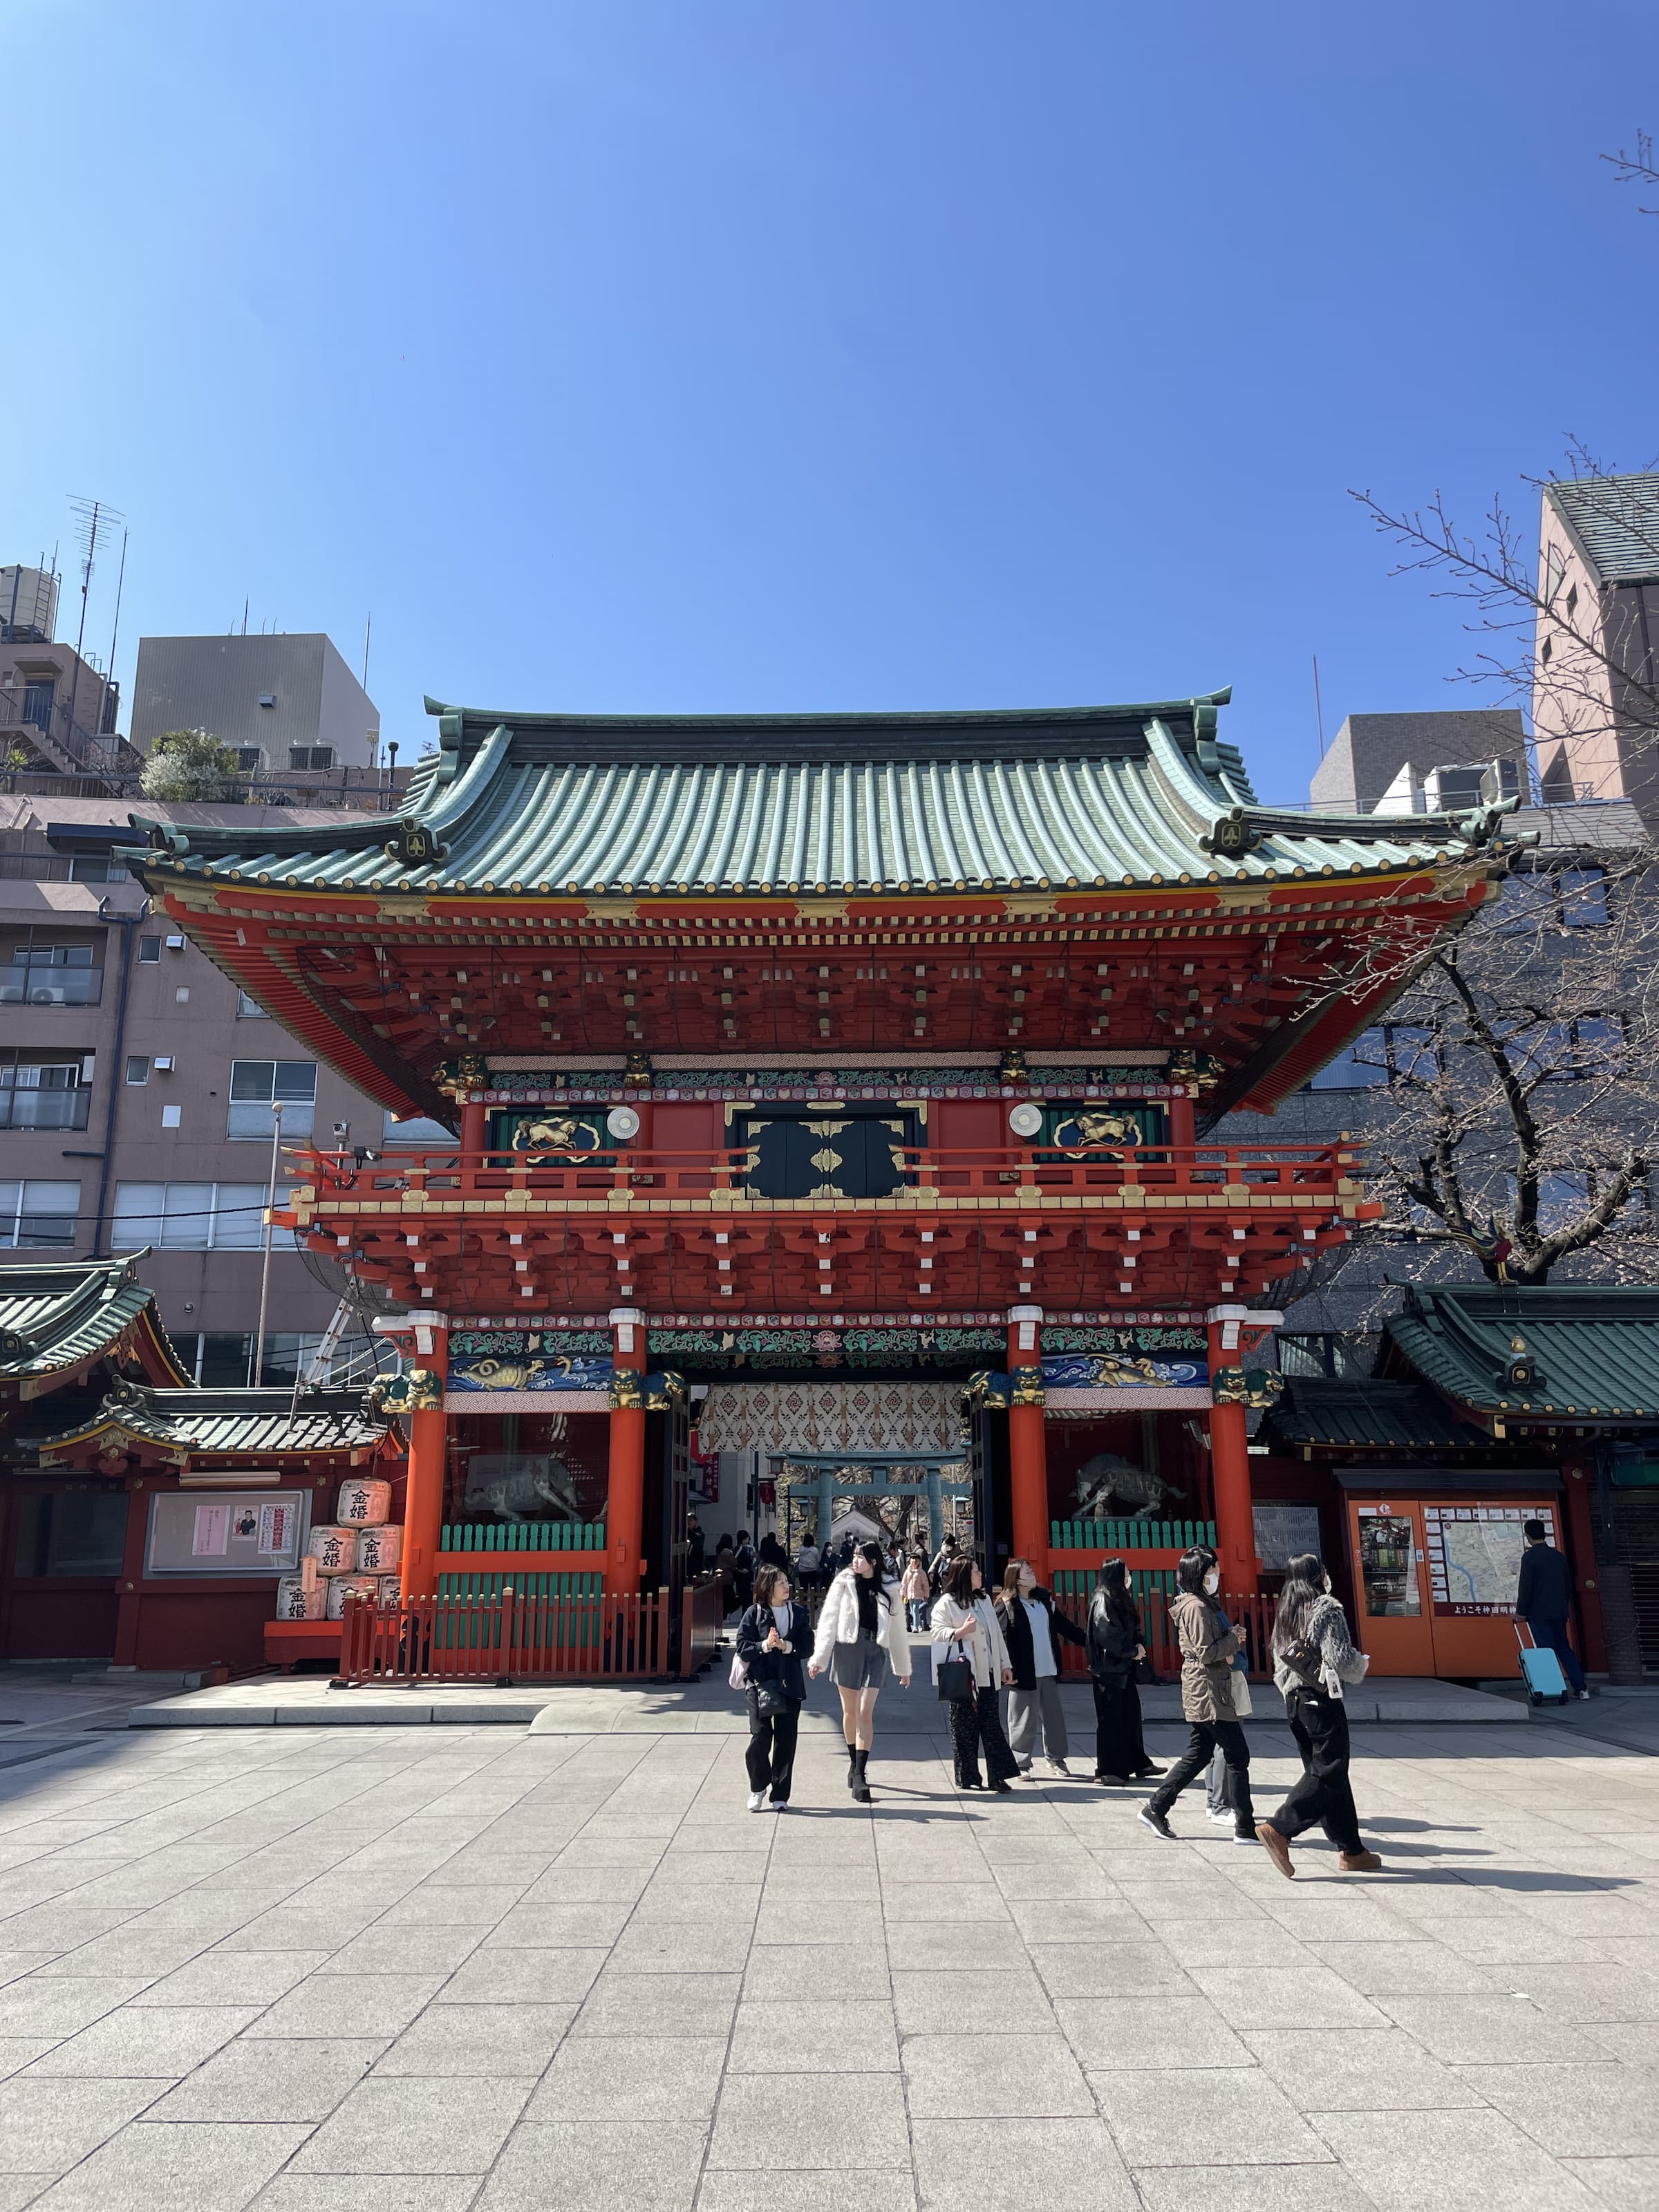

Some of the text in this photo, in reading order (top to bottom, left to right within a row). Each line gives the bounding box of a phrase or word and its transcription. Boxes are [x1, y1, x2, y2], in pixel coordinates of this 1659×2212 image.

[350, 1490, 371, 1519] 金婚
[322, 1537, 344, 1567] 金婚
[364, 1538, 381, 1568] 金婚
[288, 1588, 307, 1618] 金婚
[1454, 1605, 1517, 1614] ようこそ神田明神
